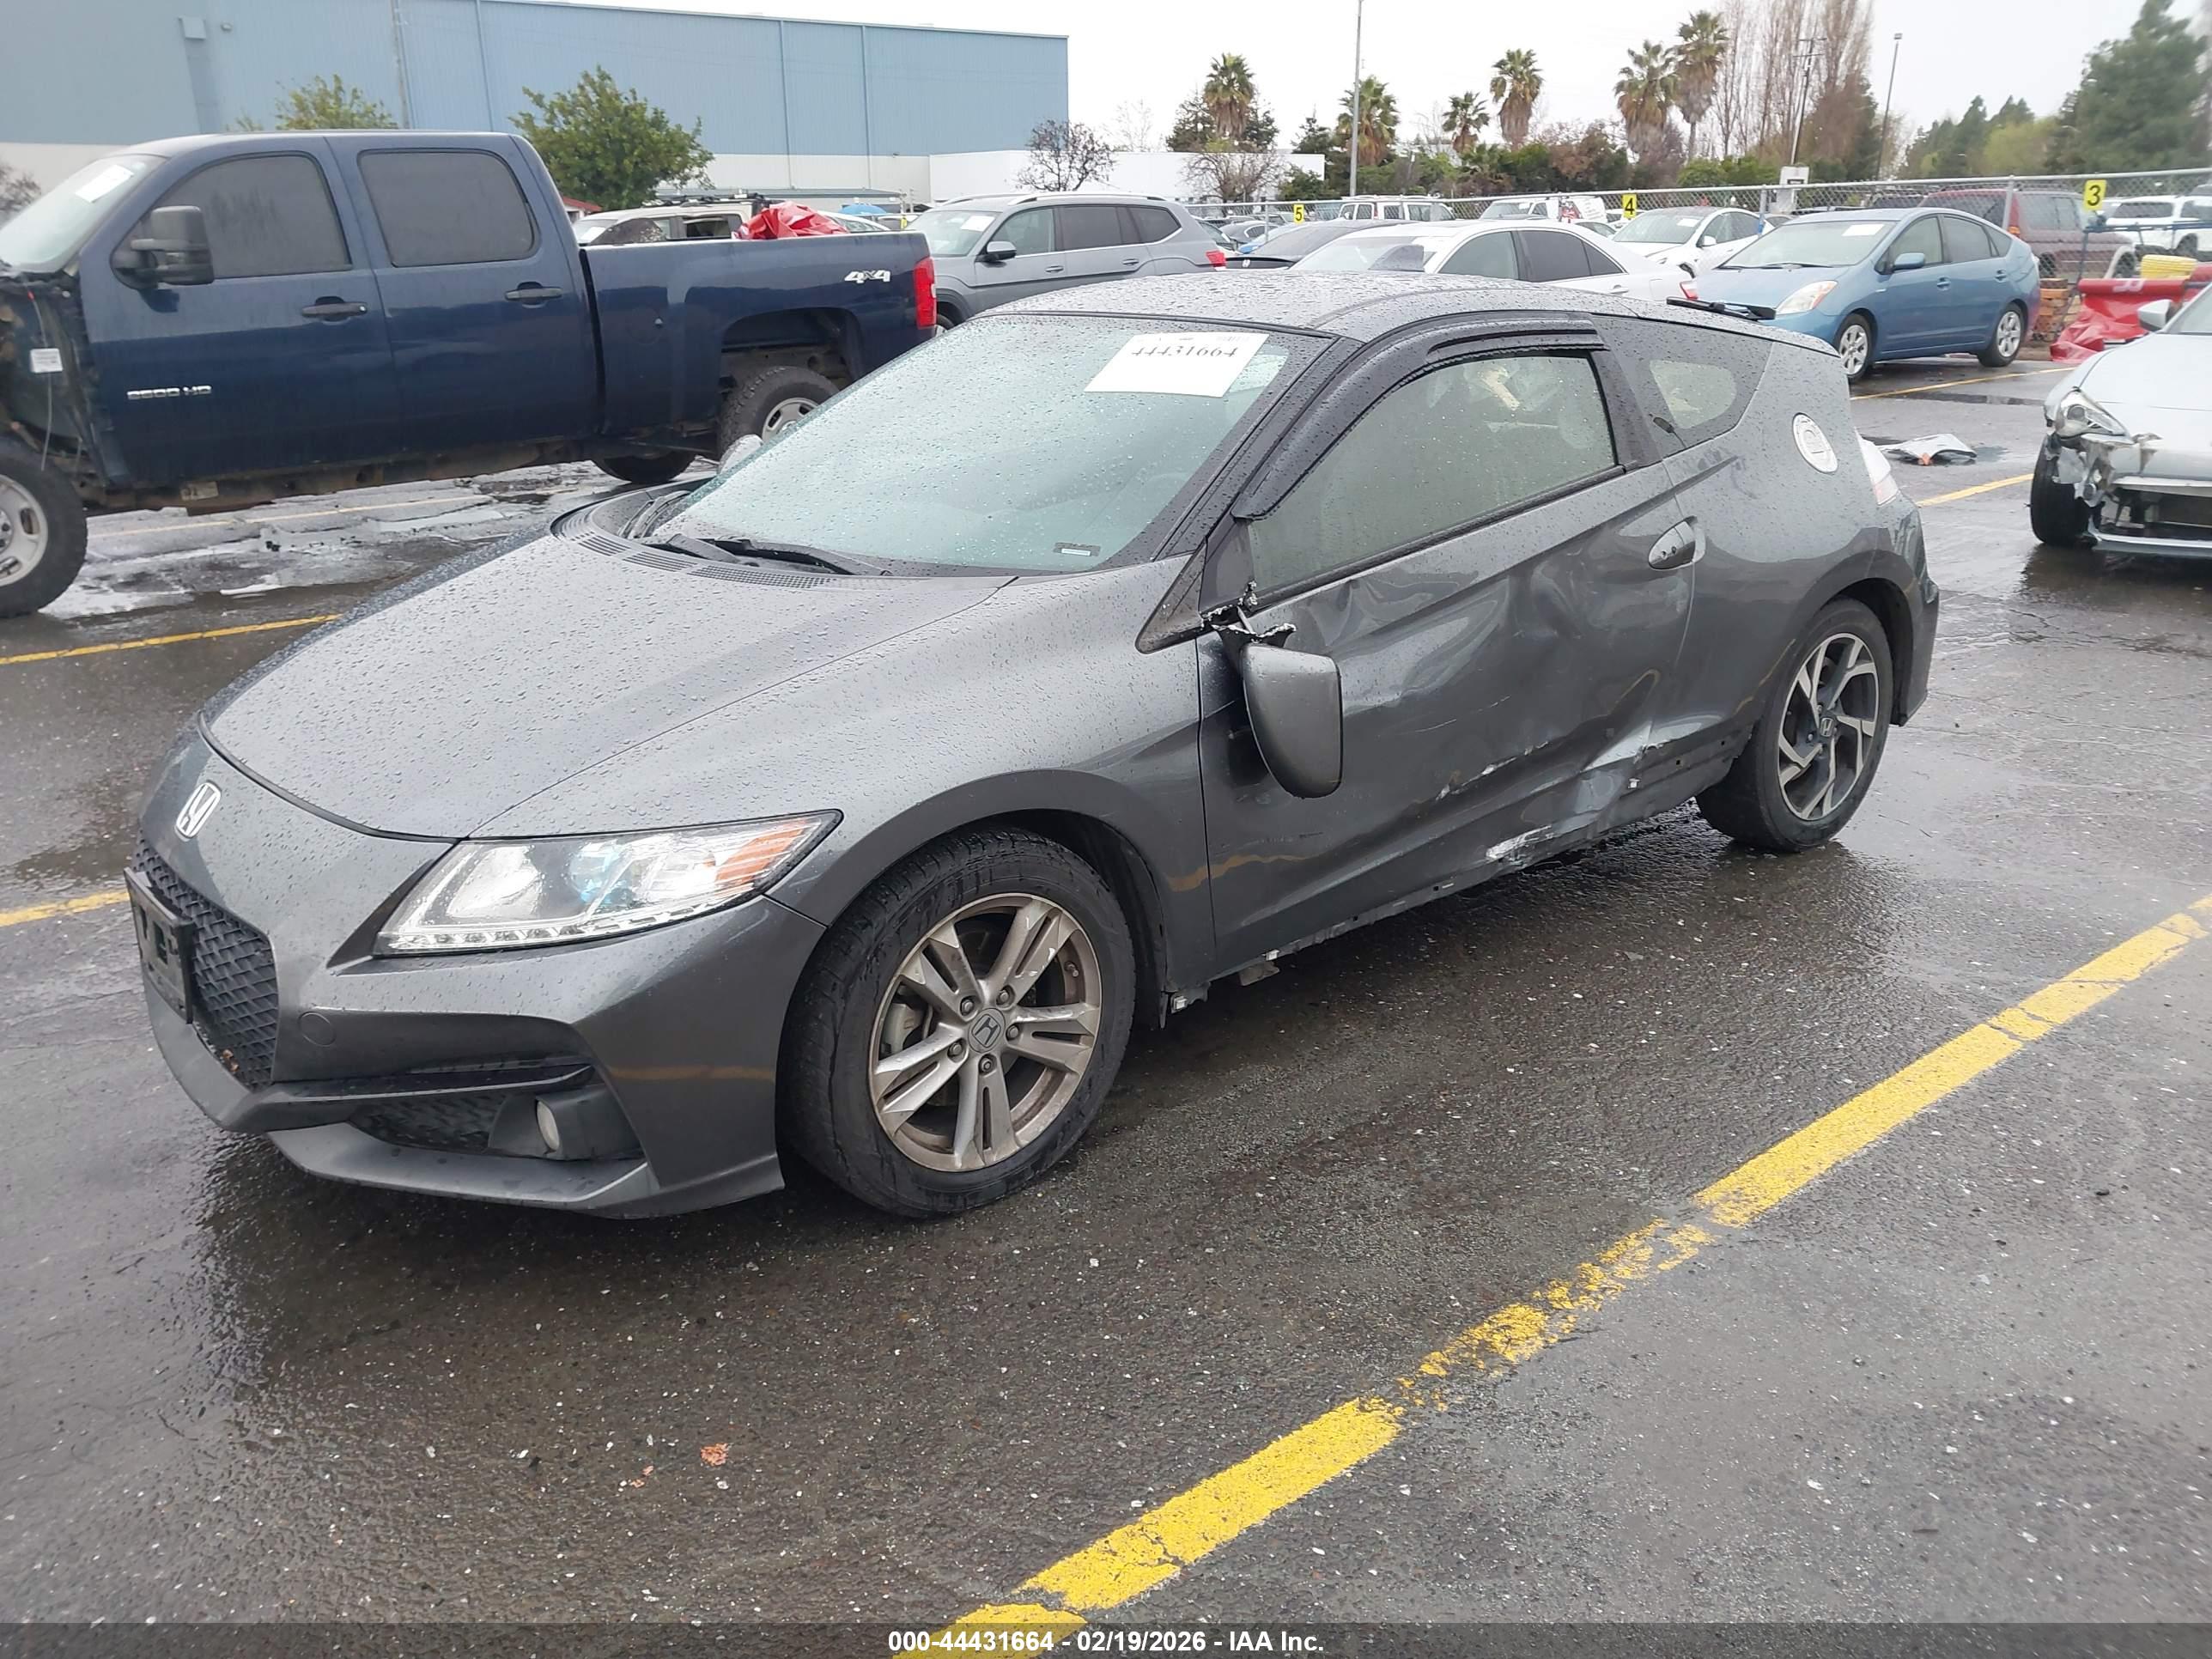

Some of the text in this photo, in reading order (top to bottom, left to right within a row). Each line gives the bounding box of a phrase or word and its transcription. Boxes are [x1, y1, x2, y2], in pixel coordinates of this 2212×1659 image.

[2087, 185, 2101, 206] 3
[1296, 207, 1302, 222] 5
[1625, 198, 1635, 216] 4
[1131, 345, 1238, 358] 44431664
